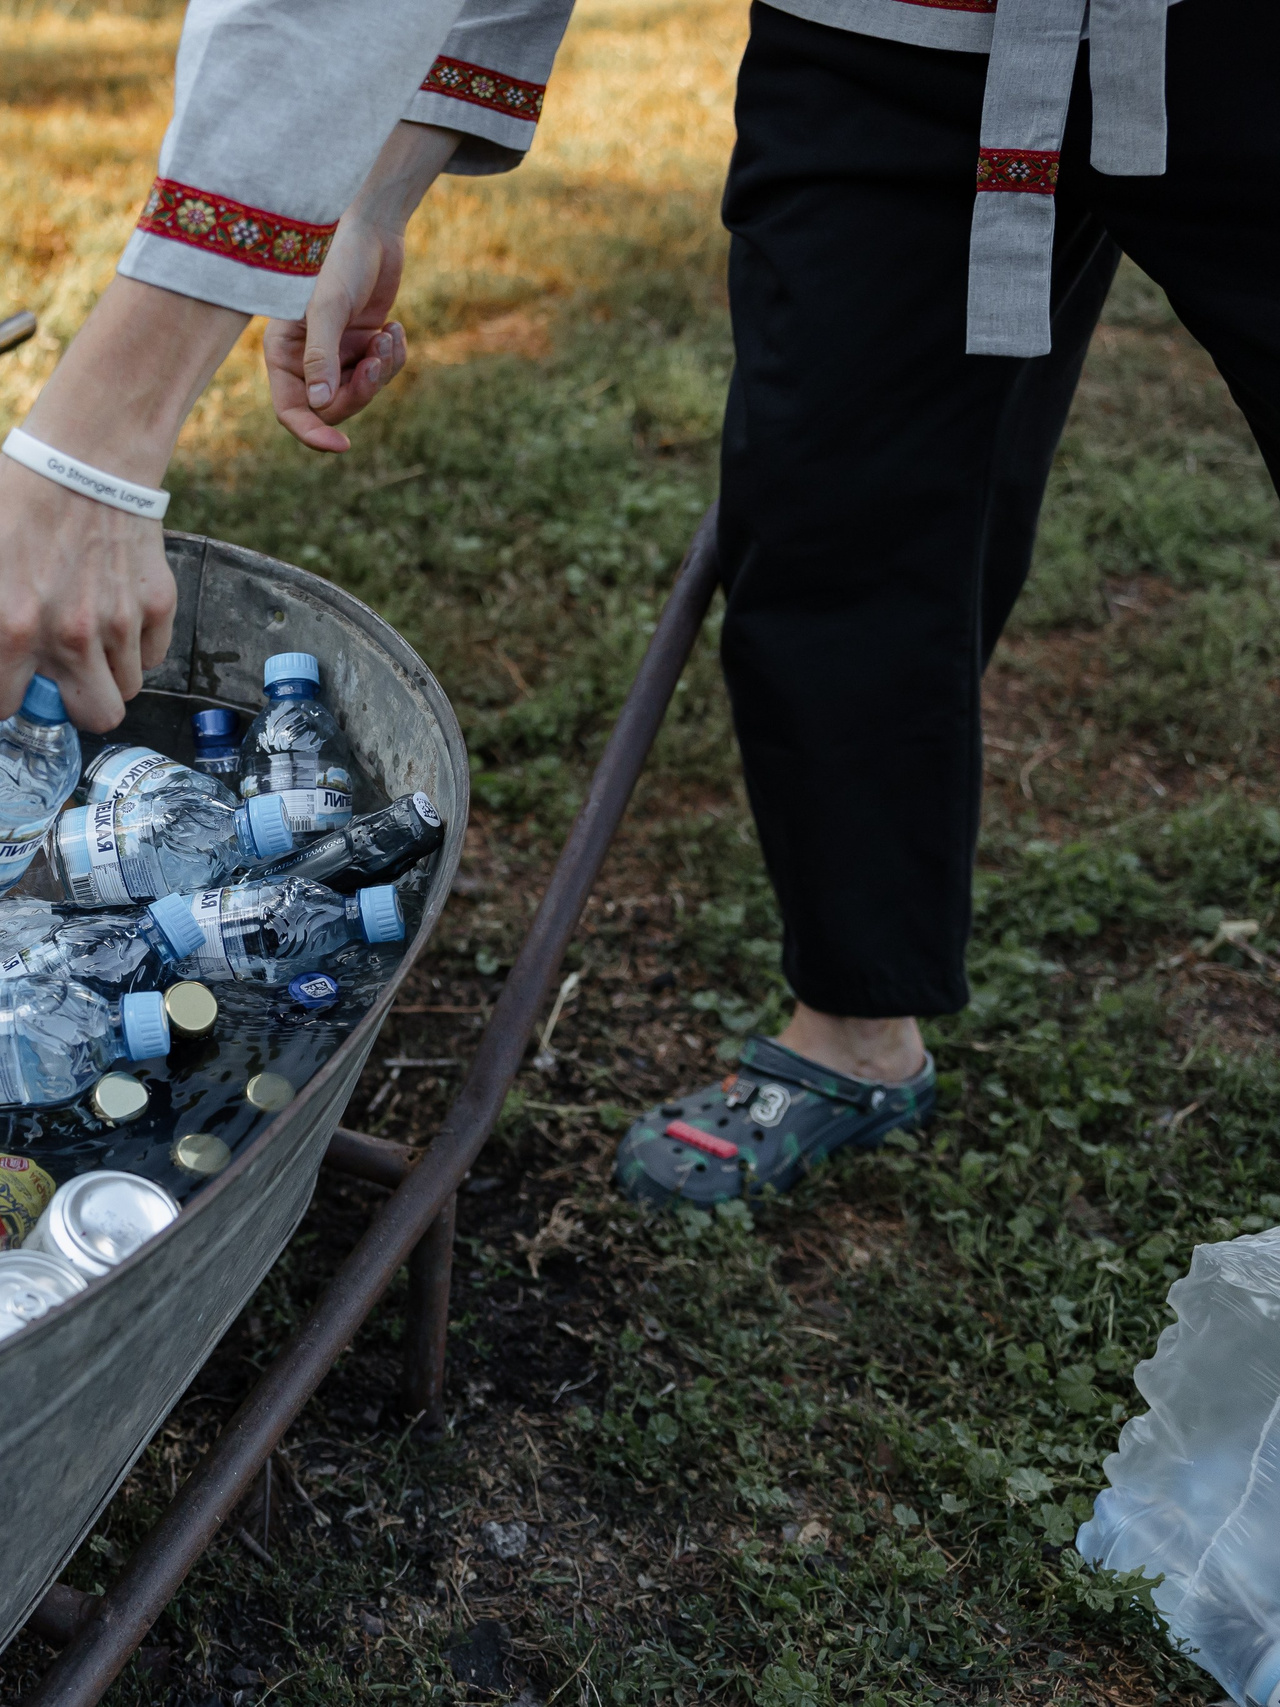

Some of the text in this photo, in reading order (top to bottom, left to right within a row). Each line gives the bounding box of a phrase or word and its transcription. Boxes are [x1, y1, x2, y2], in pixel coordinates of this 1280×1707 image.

[47, 458, 65, 474] Go
[121, 489, 156, 509] Longer
[305, 837, 345, 860] TAMAGNE
[752, 1087, 788, 1124] 3
